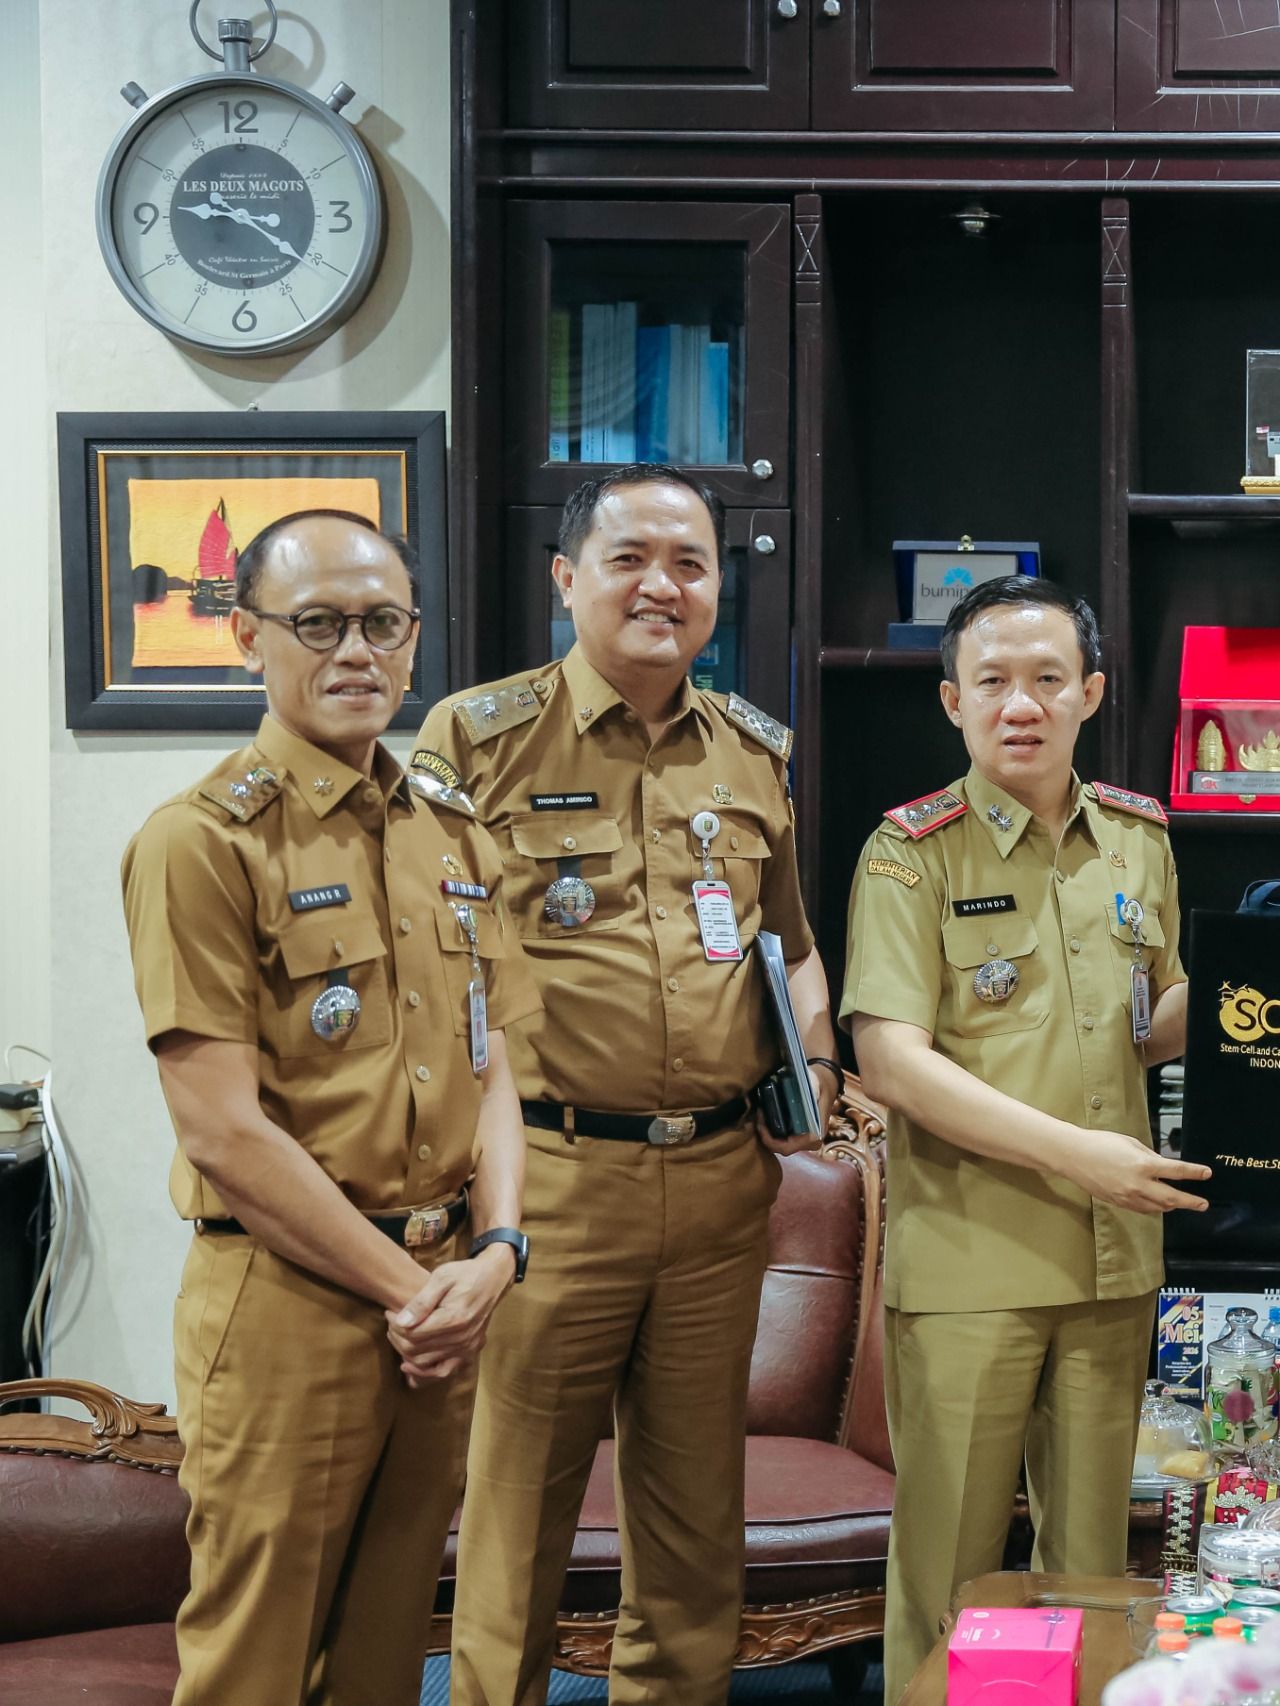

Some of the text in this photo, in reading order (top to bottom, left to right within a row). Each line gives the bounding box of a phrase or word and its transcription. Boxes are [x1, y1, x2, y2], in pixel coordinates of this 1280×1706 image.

[218, 100, 259, 133] 12
[192, 137, 205, 149] 55
[280, 138, 288, 148] 5
[162, 168, 174, 182] 50
[309, 167, 321, 180] 10
[183, 180, 304, 192] LES DEUX MAGOTS
[133, 202, 160, 235] 9
[328, 201, 352, 233] 3
[164, 253, 176, 266] 40
[311, 253, 323, 266] 20
[280, 285, 293, 296] 25
[232, 300, 257, 333] 6
[536, 797, 564, 805] THOMAS
[871, 860, 916, 879] KEMENTERIAN
[300, 888, 342, 904] ANANG R
[963, 899, 1006, 911] MARINDO
[1220, 1043, 1239, 1053] Stem
[1240, 1045, 1256, 1054] Cell
[1256, 1046, 1270, 1056] and
[1246, 1157, 1268, 1168] Best
[1182, 1305, 1200, 1321] 05
[1164, 1323, 1200, 1344] Mei
